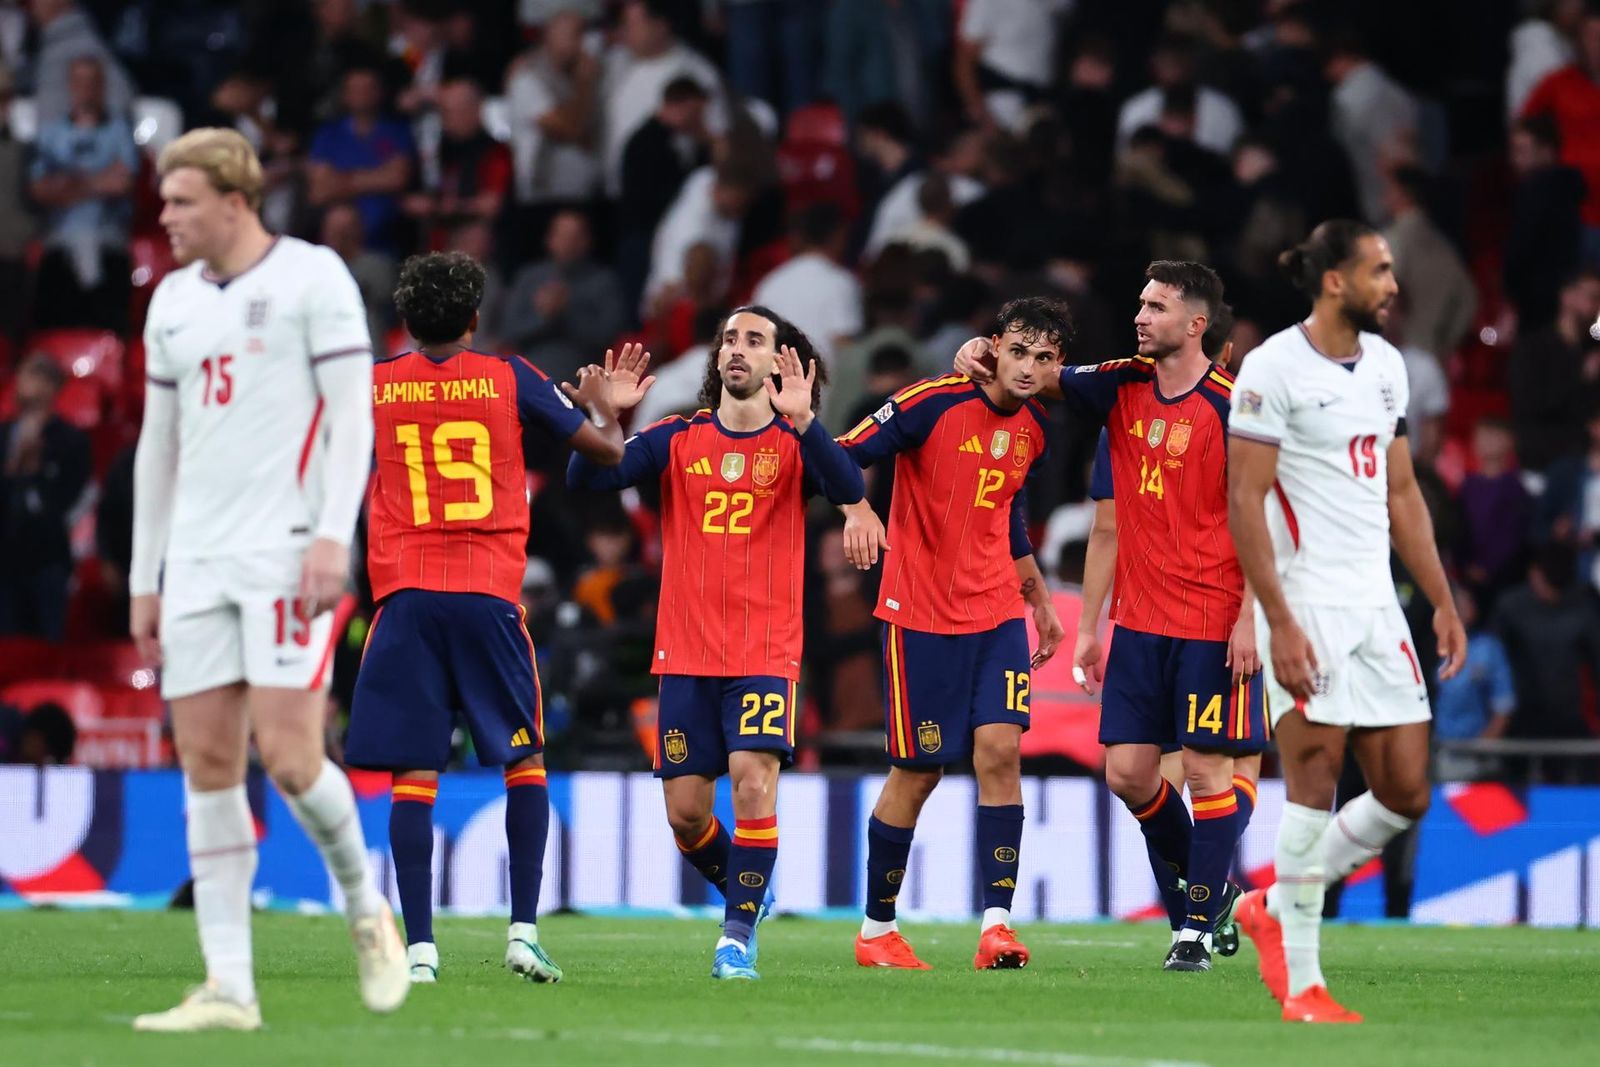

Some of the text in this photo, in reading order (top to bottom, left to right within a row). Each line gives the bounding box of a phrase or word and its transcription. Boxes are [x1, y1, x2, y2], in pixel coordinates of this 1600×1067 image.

[201, 353, 235, 407] 15
[373, 378, 500, 405] LAMINE YAMAL
[395, 420, 494, 527] 19
[1138, 455, 1164, 500] 14
[1348, 434, 1377, 478] 19
[974, 467, 1006, 510] 12
[702, 491, 754, 534] 22
[1400, 640, 1421, 685] 1
[1004, 670, 1030, 714] 12
[1186, 693, 1223, 735] 14
[739, 692, 786, 737] 22
